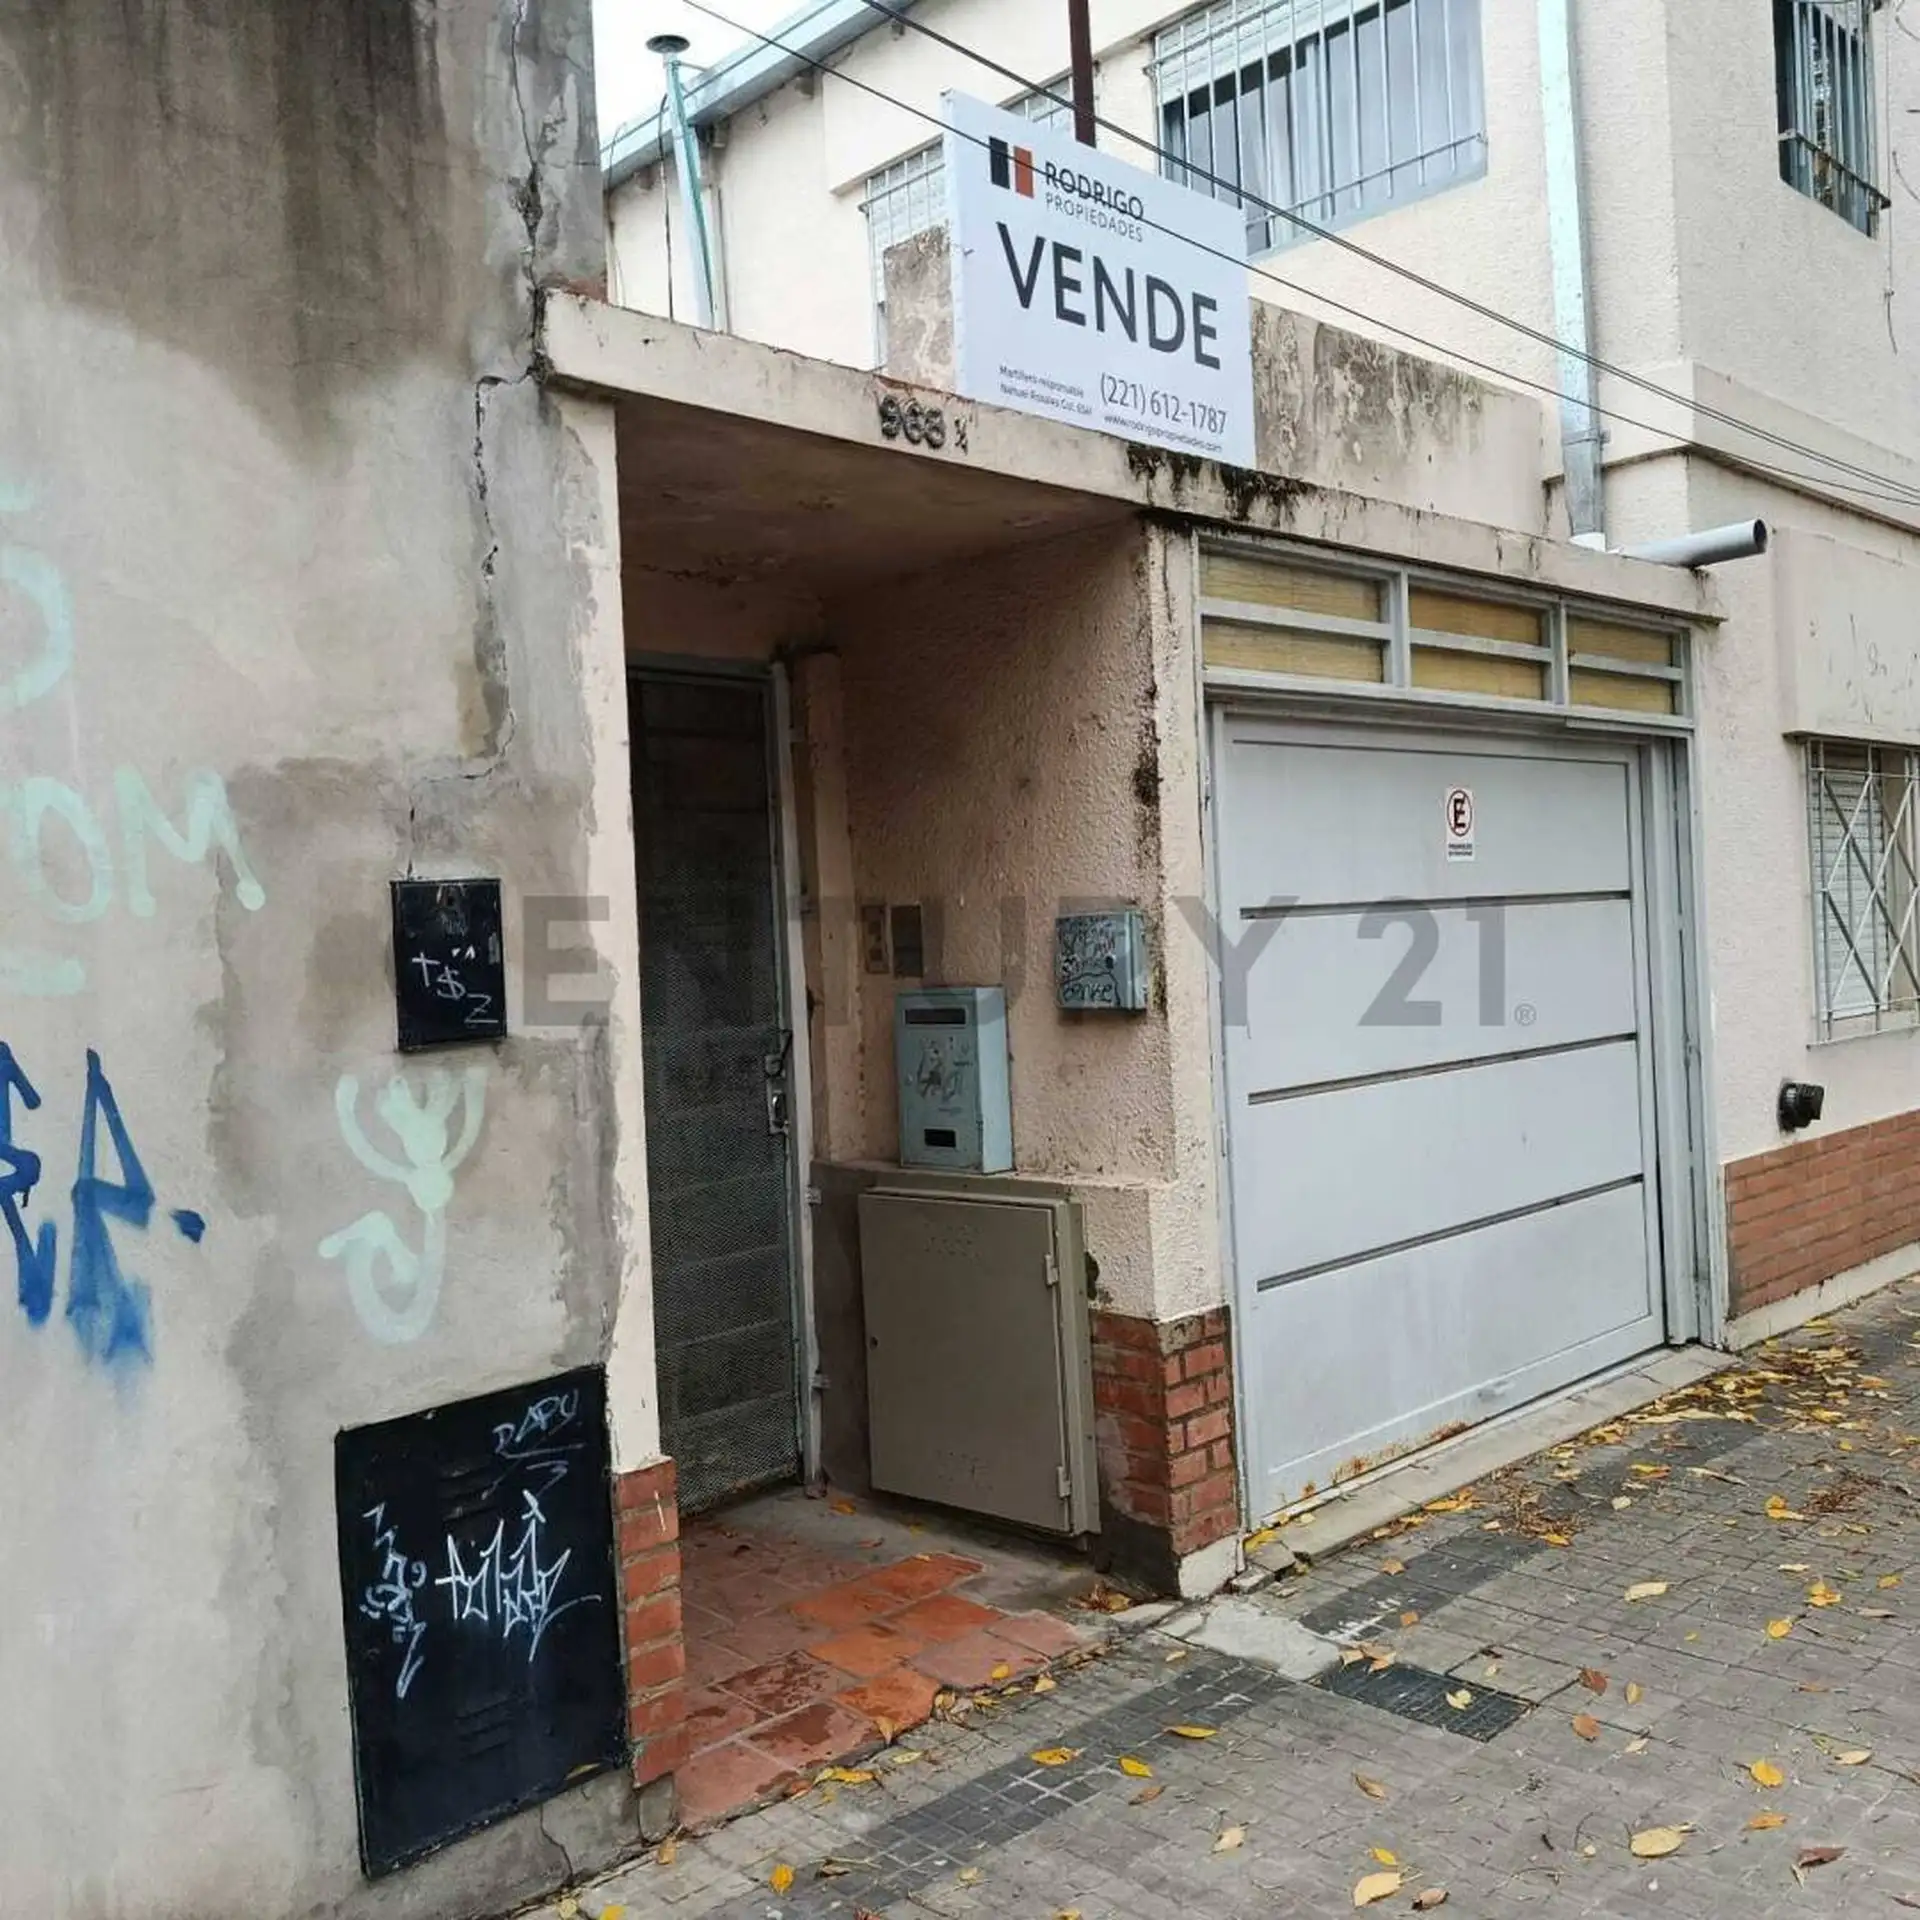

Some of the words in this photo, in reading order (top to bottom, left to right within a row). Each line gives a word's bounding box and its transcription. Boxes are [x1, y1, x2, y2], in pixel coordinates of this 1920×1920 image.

[1045, 161, 1144, 221] RODRIGO
[1045, 191, 1143, 243] PROPIEDADES
[996, 221, 1221, 370] VENDE
[1100, 372, 1146, 416] (221)
[1149, 390, 1227, 436] 612-1787
